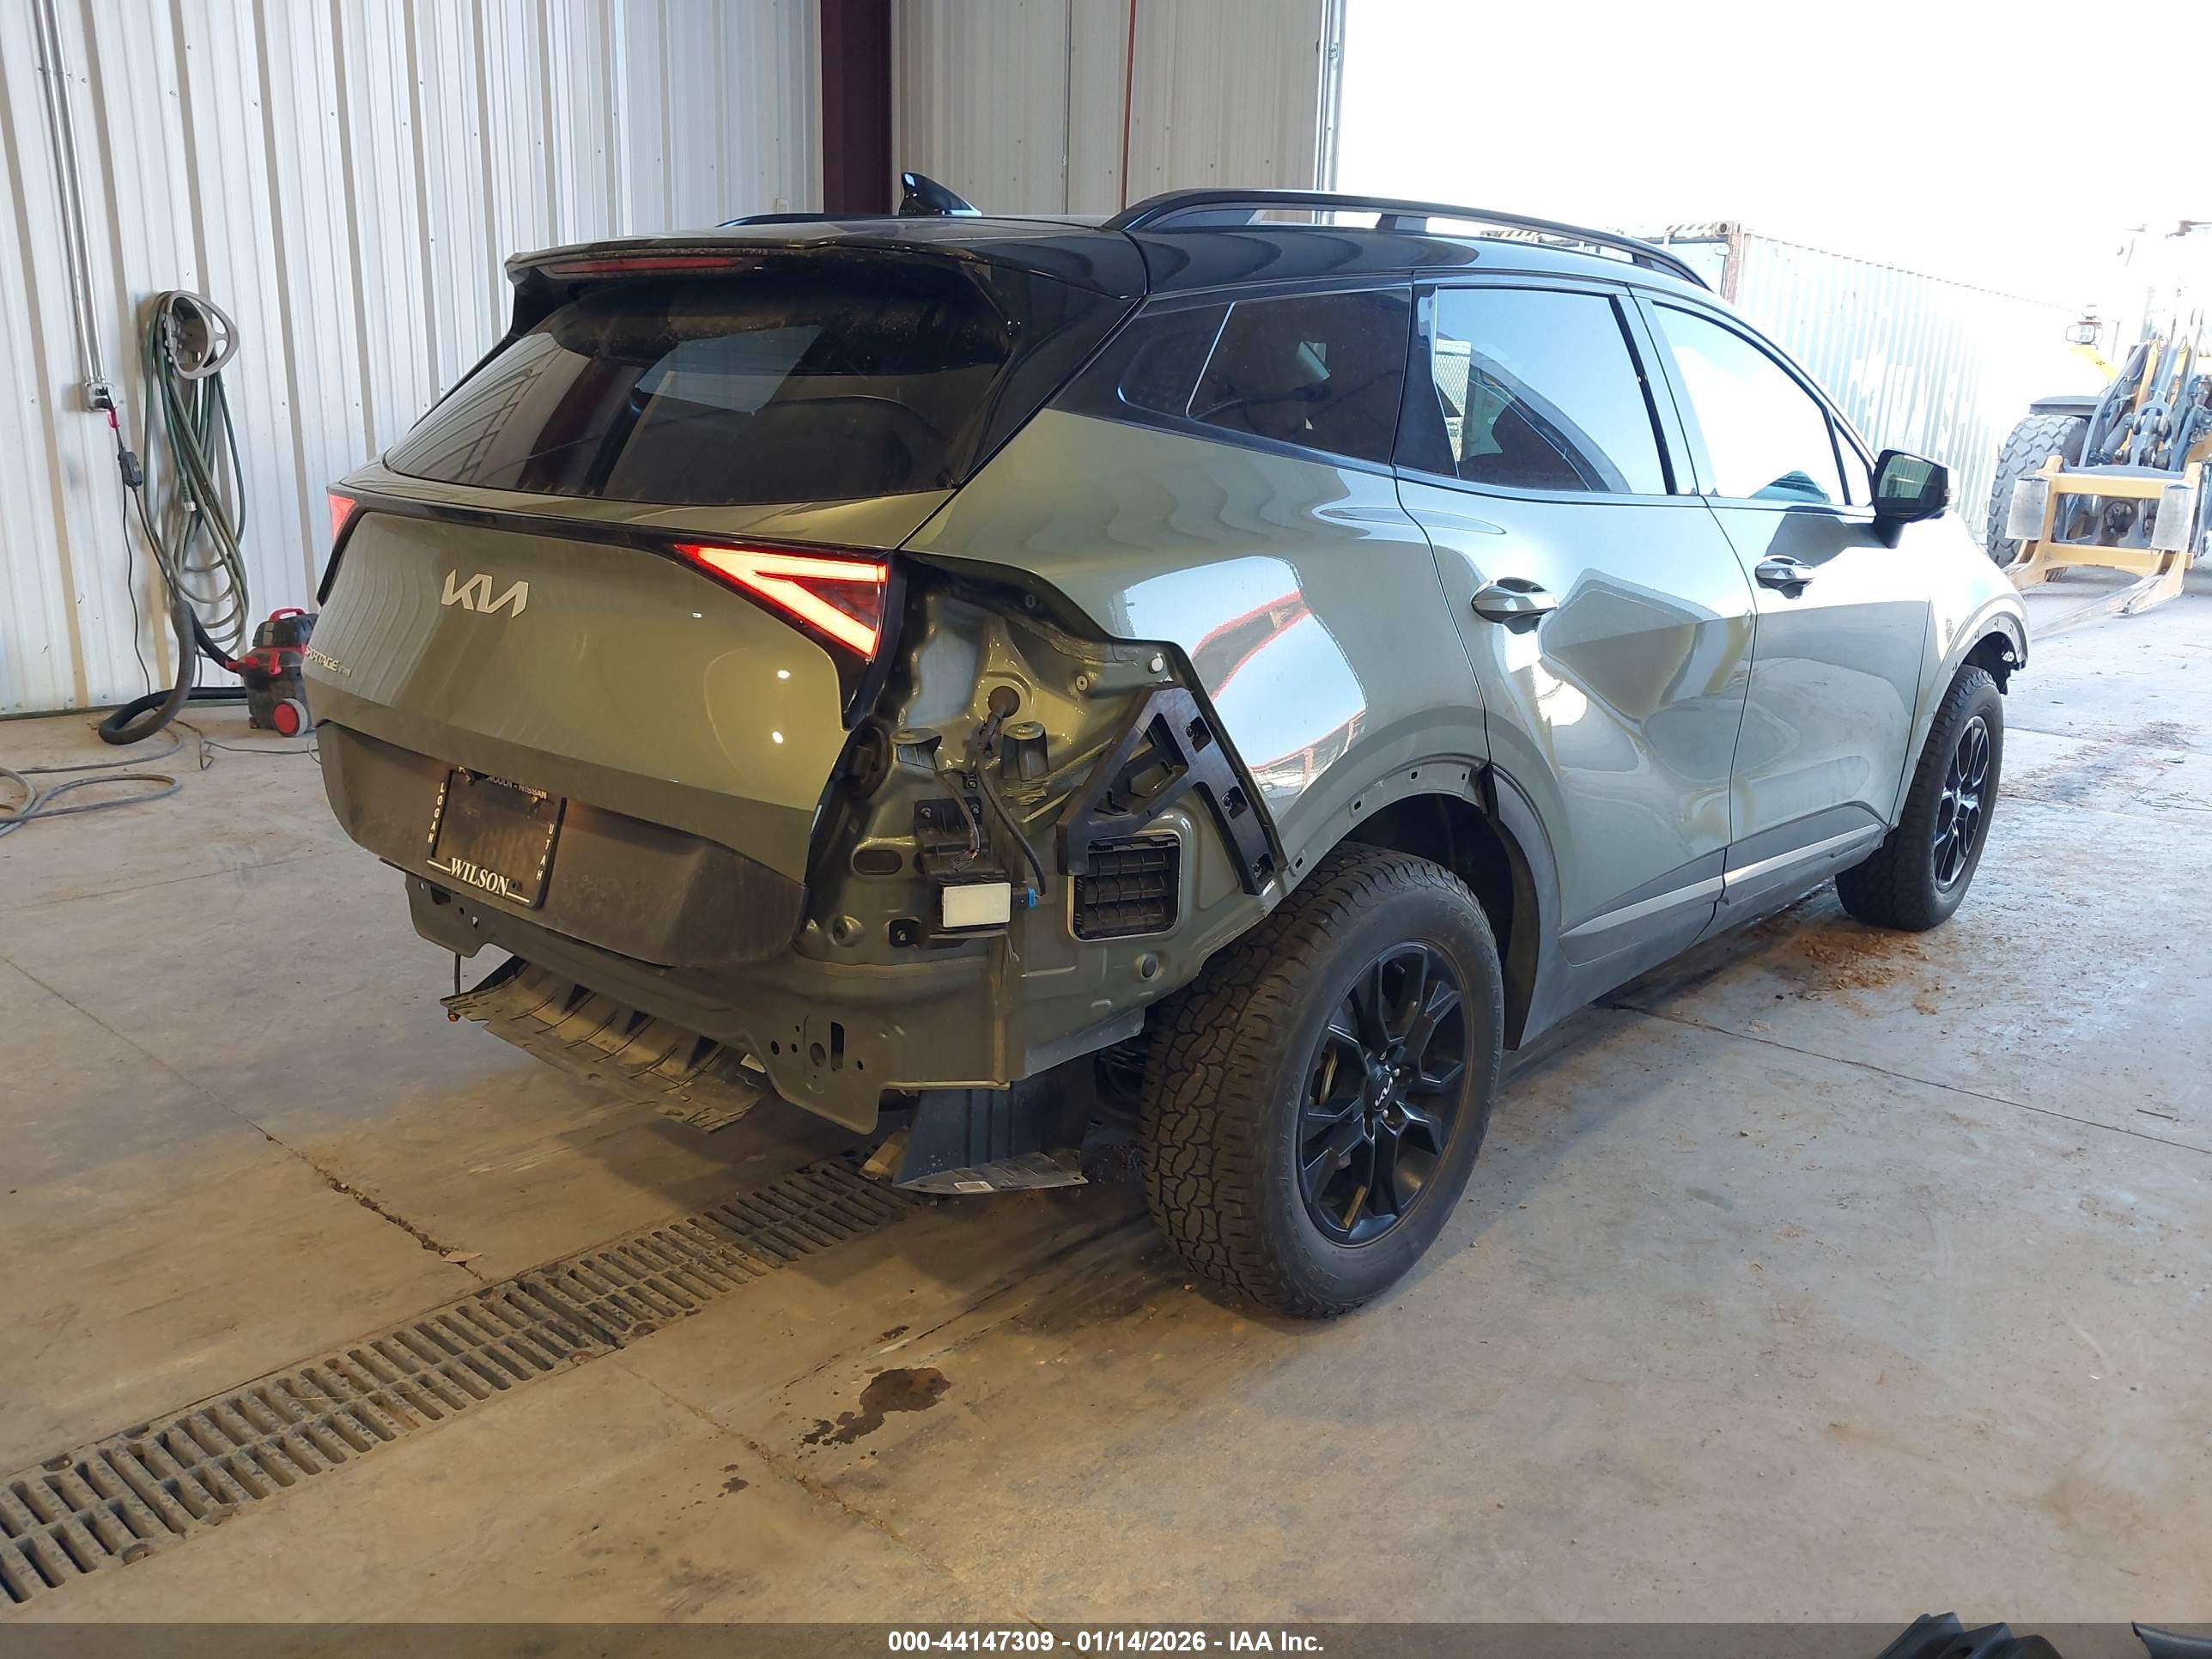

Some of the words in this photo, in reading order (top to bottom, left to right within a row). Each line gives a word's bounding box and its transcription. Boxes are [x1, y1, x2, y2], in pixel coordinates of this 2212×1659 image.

[441, 568, 529, 618] KIA
[427, 781, 445, 844] LOGAN
[518, 784, 547, 799] NISSAN
[451, 857, 511, 896] WILSON
[535, 823, 555, 881] UTAH
